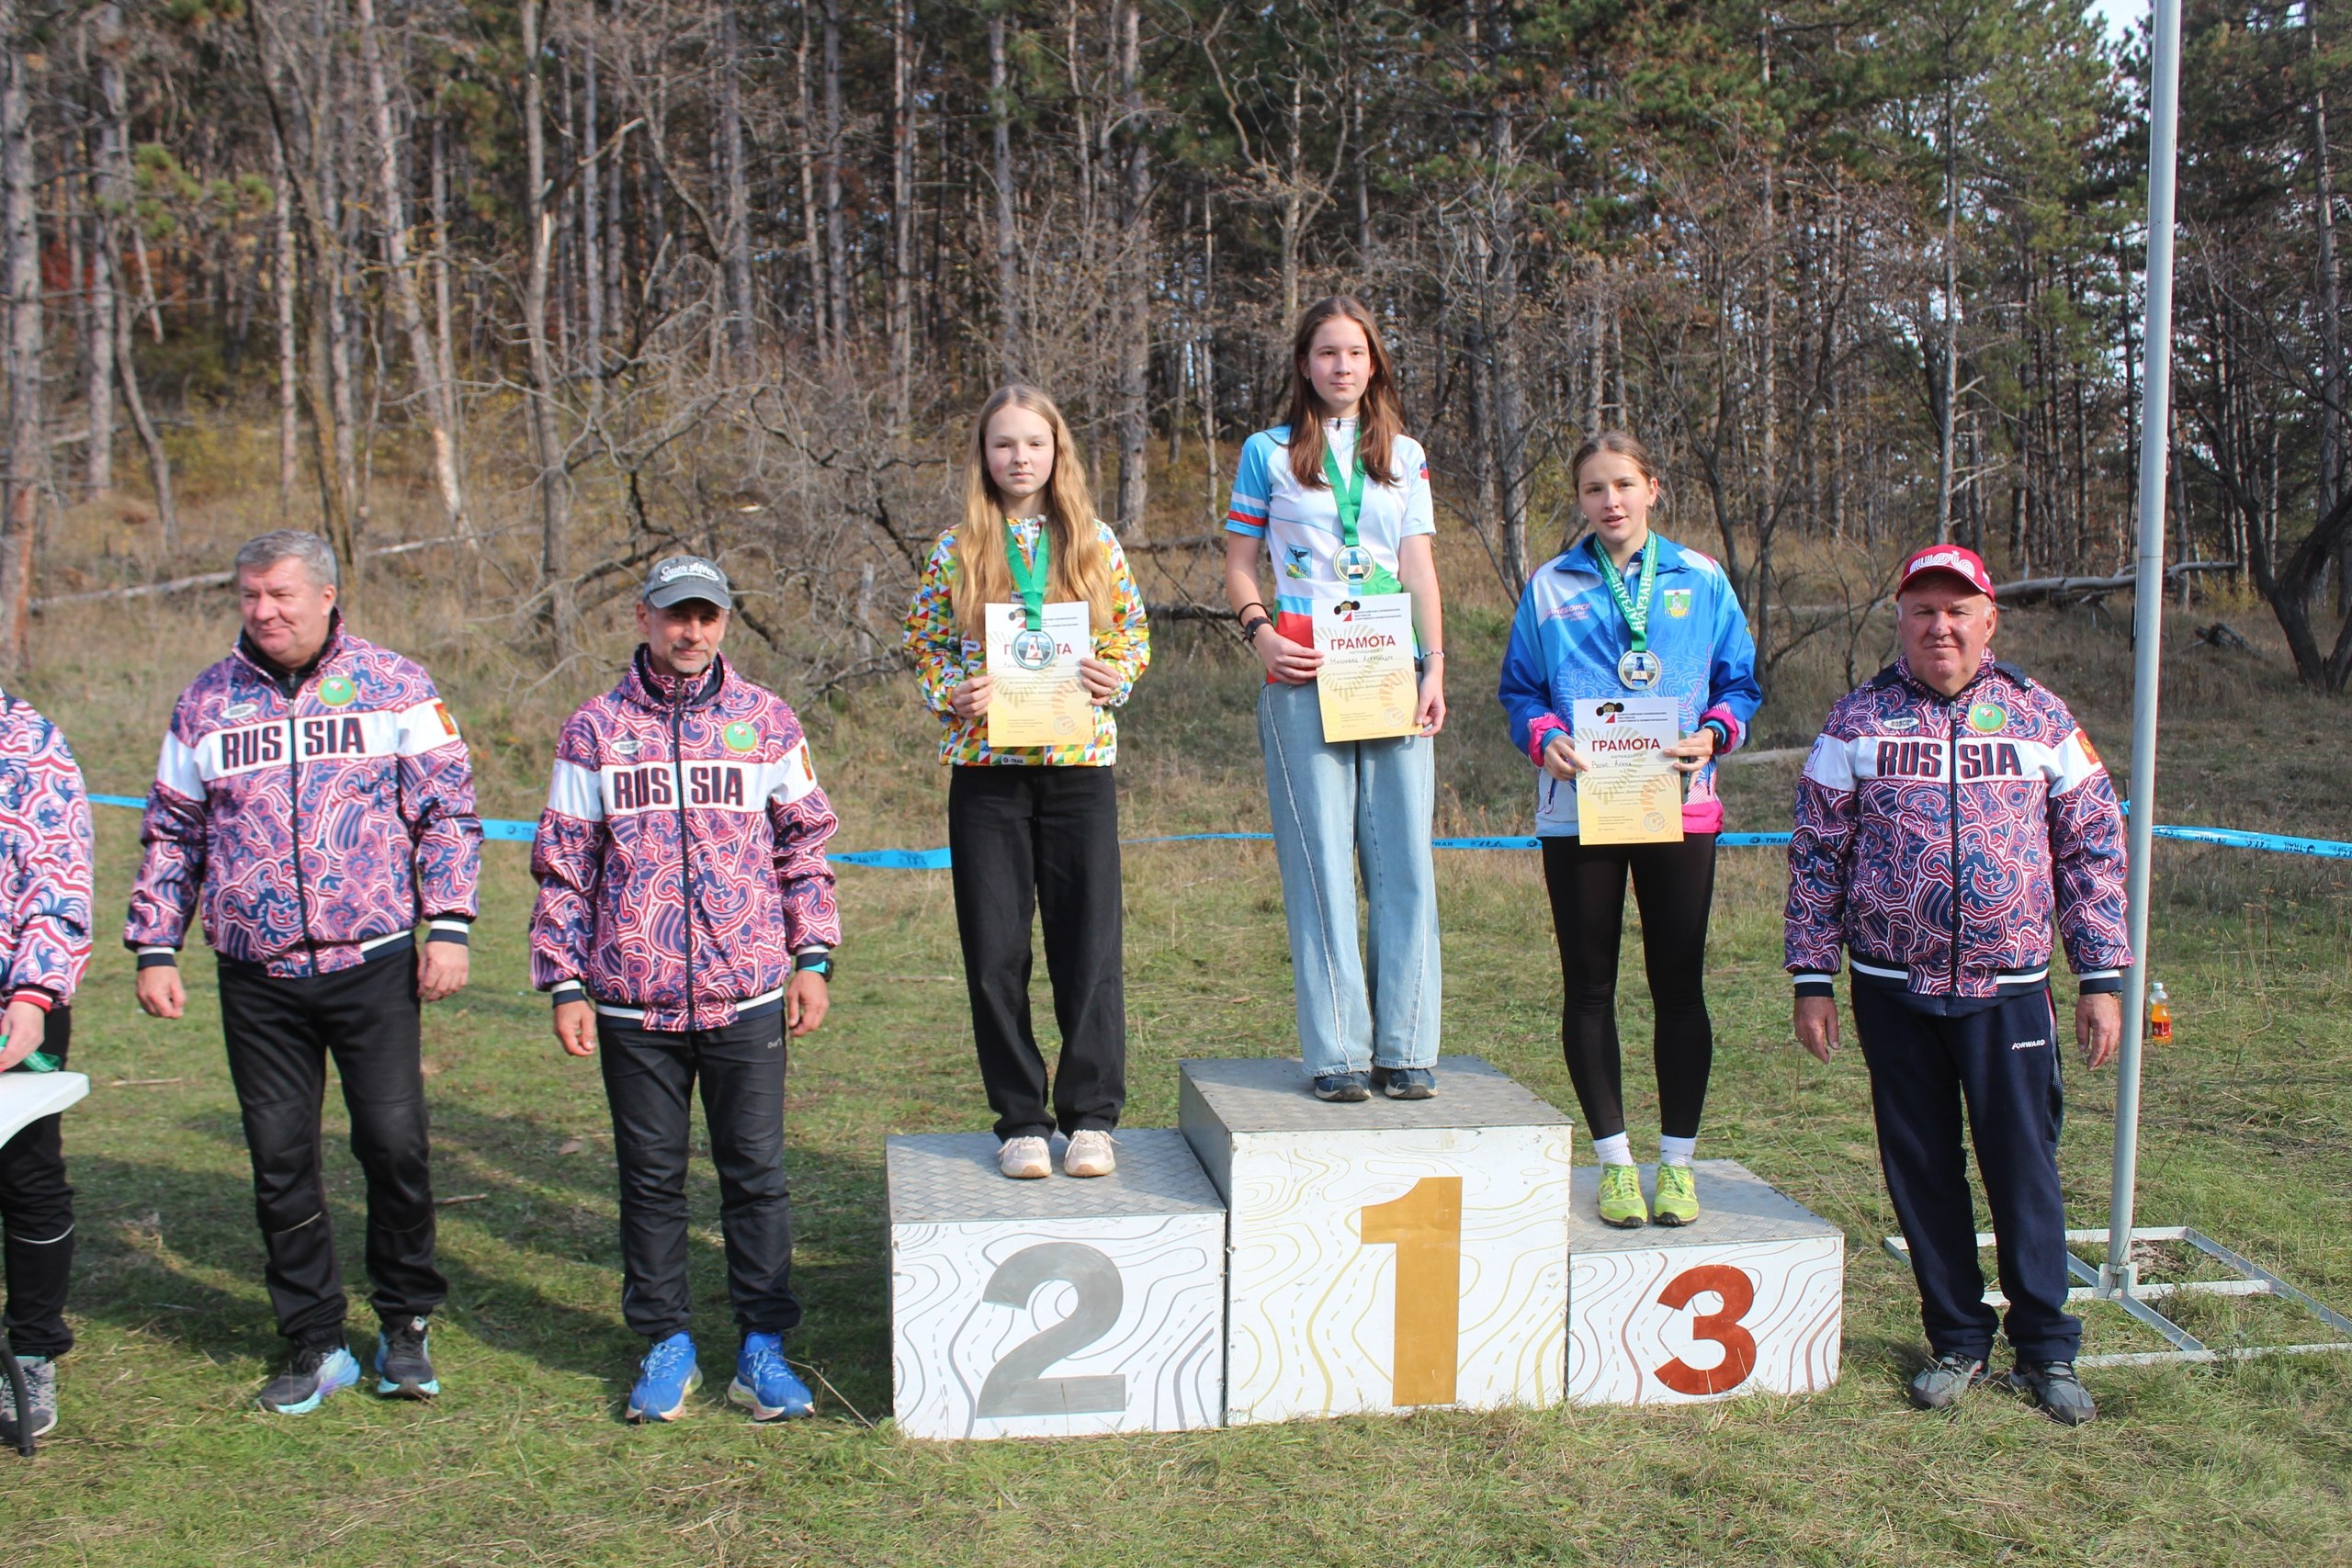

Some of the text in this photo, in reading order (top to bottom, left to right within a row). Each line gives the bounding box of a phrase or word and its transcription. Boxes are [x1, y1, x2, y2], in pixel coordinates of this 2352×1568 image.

[1612, 581, 1642, 630] НАРЗАН
[1330, 635, 1396, 650] ГРАМОТА
[221, 717, 366, 770] RUSSIA
[1592, 738, 1661, 751] ГРАМОТА
[1877, 740, 2022, 779] RUSSIA
[614, 766, 743, 809] RUSSIA
[1360, 1176, 1462, 1407] 1
[977, 1242, 1125, 1418] 2
[1654, 1264, 1758, 1395] 3
